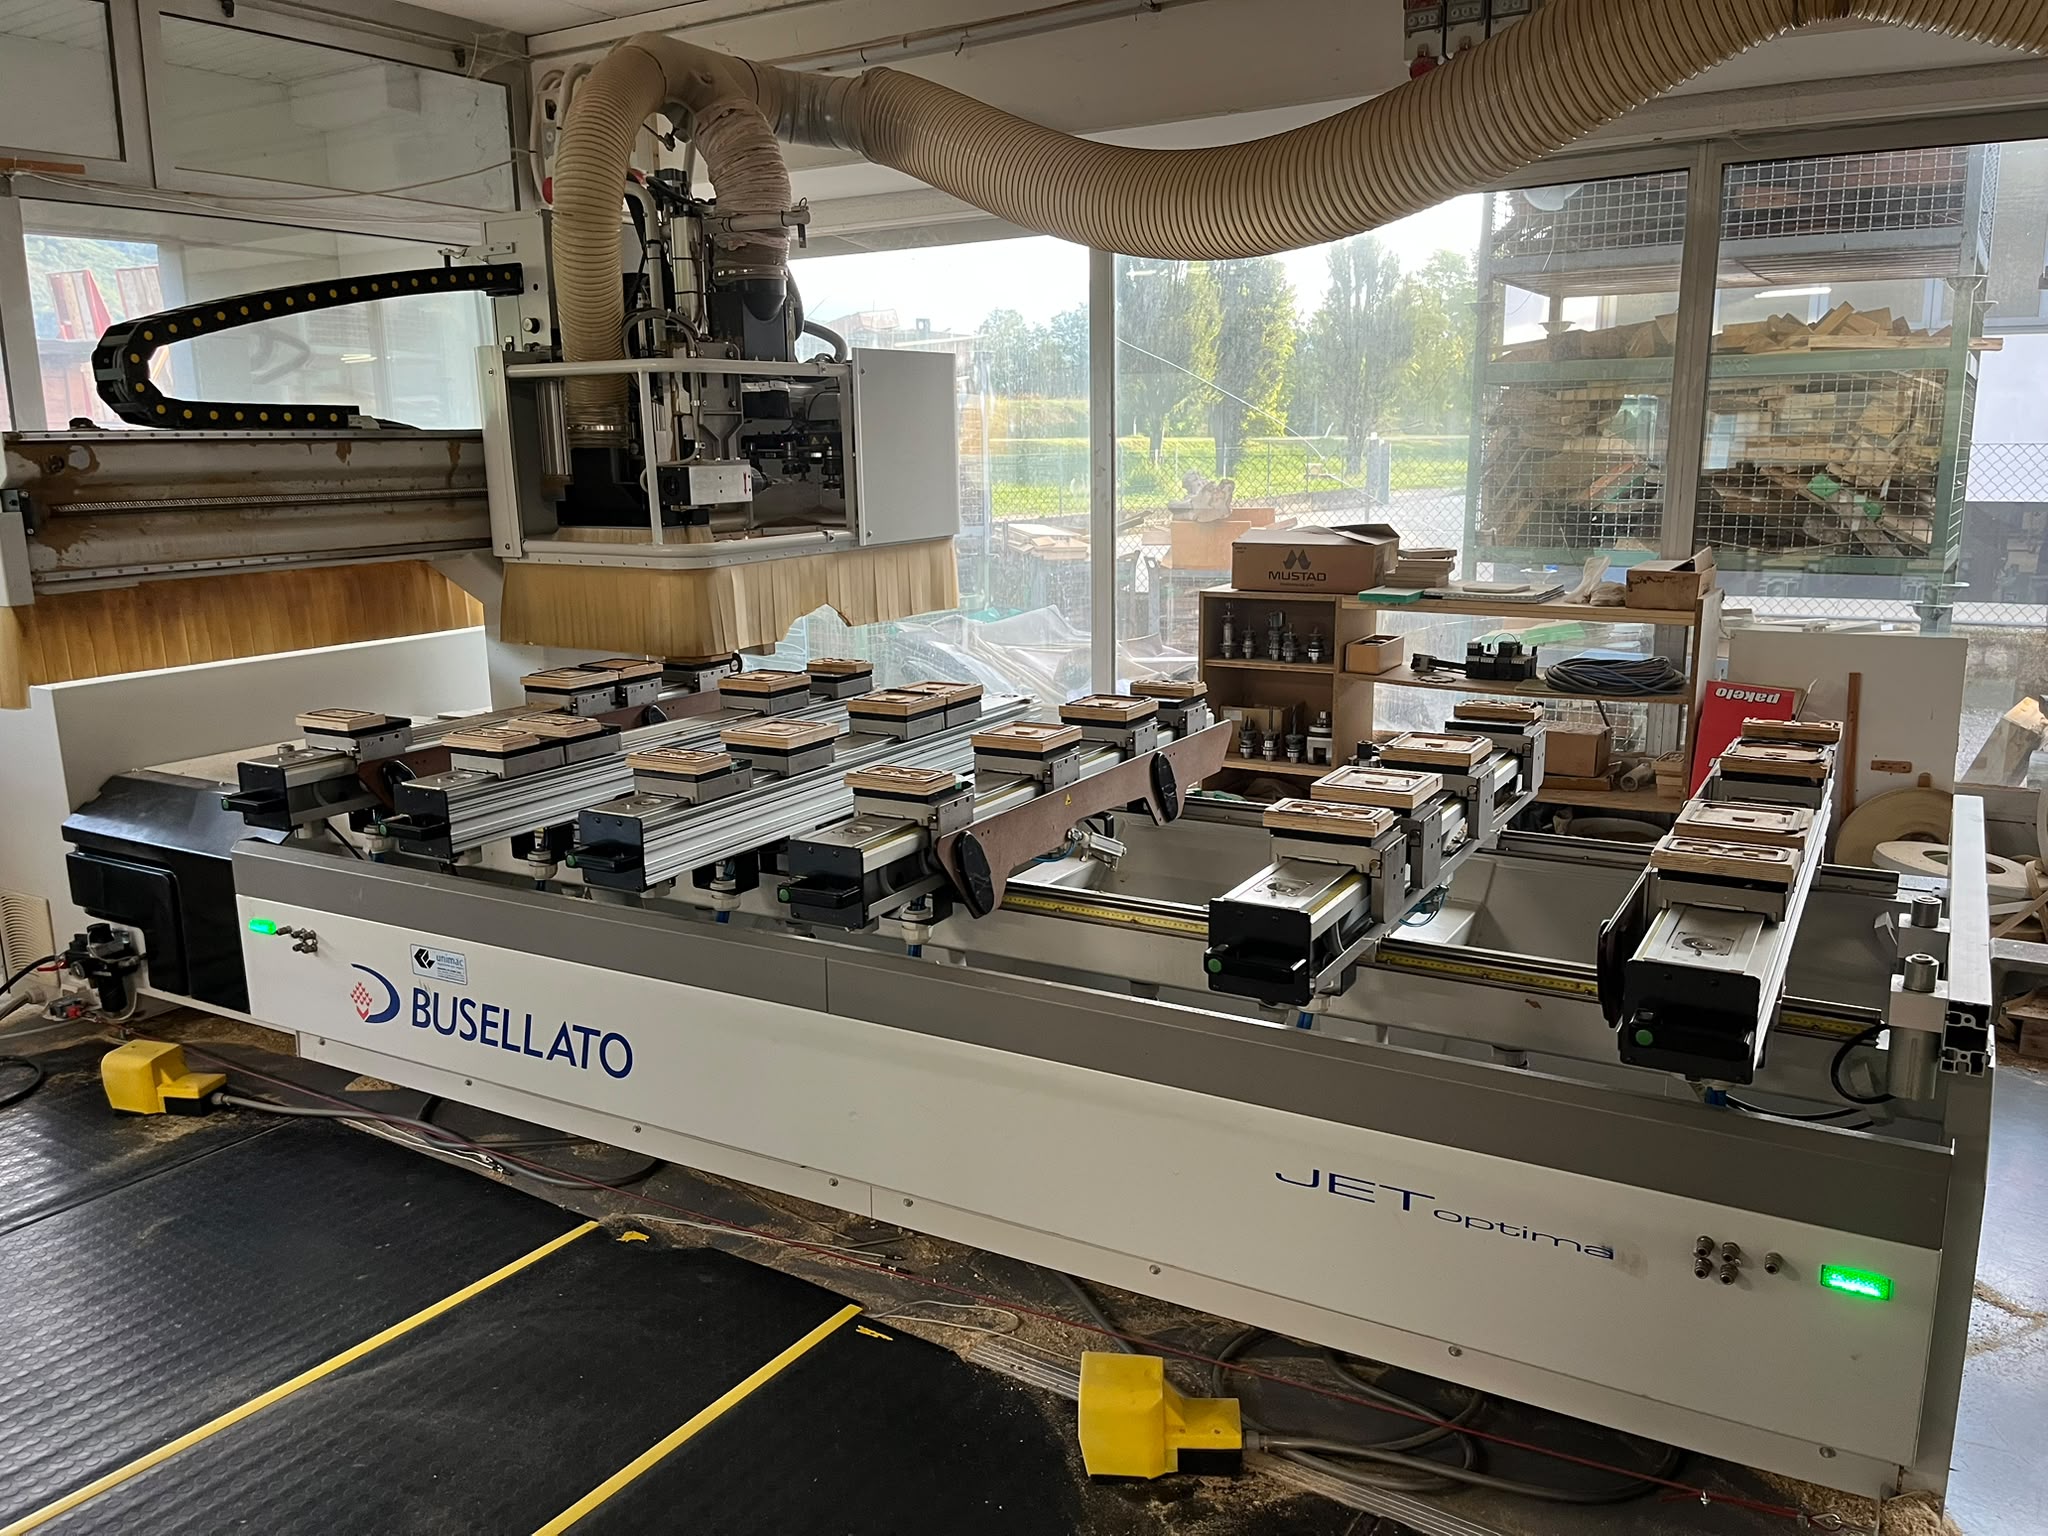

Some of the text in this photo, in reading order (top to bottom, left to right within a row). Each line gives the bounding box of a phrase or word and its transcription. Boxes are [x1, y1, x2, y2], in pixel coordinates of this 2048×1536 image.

[1268, 571, 1327, 582] MUSTAD
[1715, 687, 1782, 704] pakelo
[411, 987, 633, 1079] BUSELLATO
[1275, 1169, 1614, 1260] JET optima
